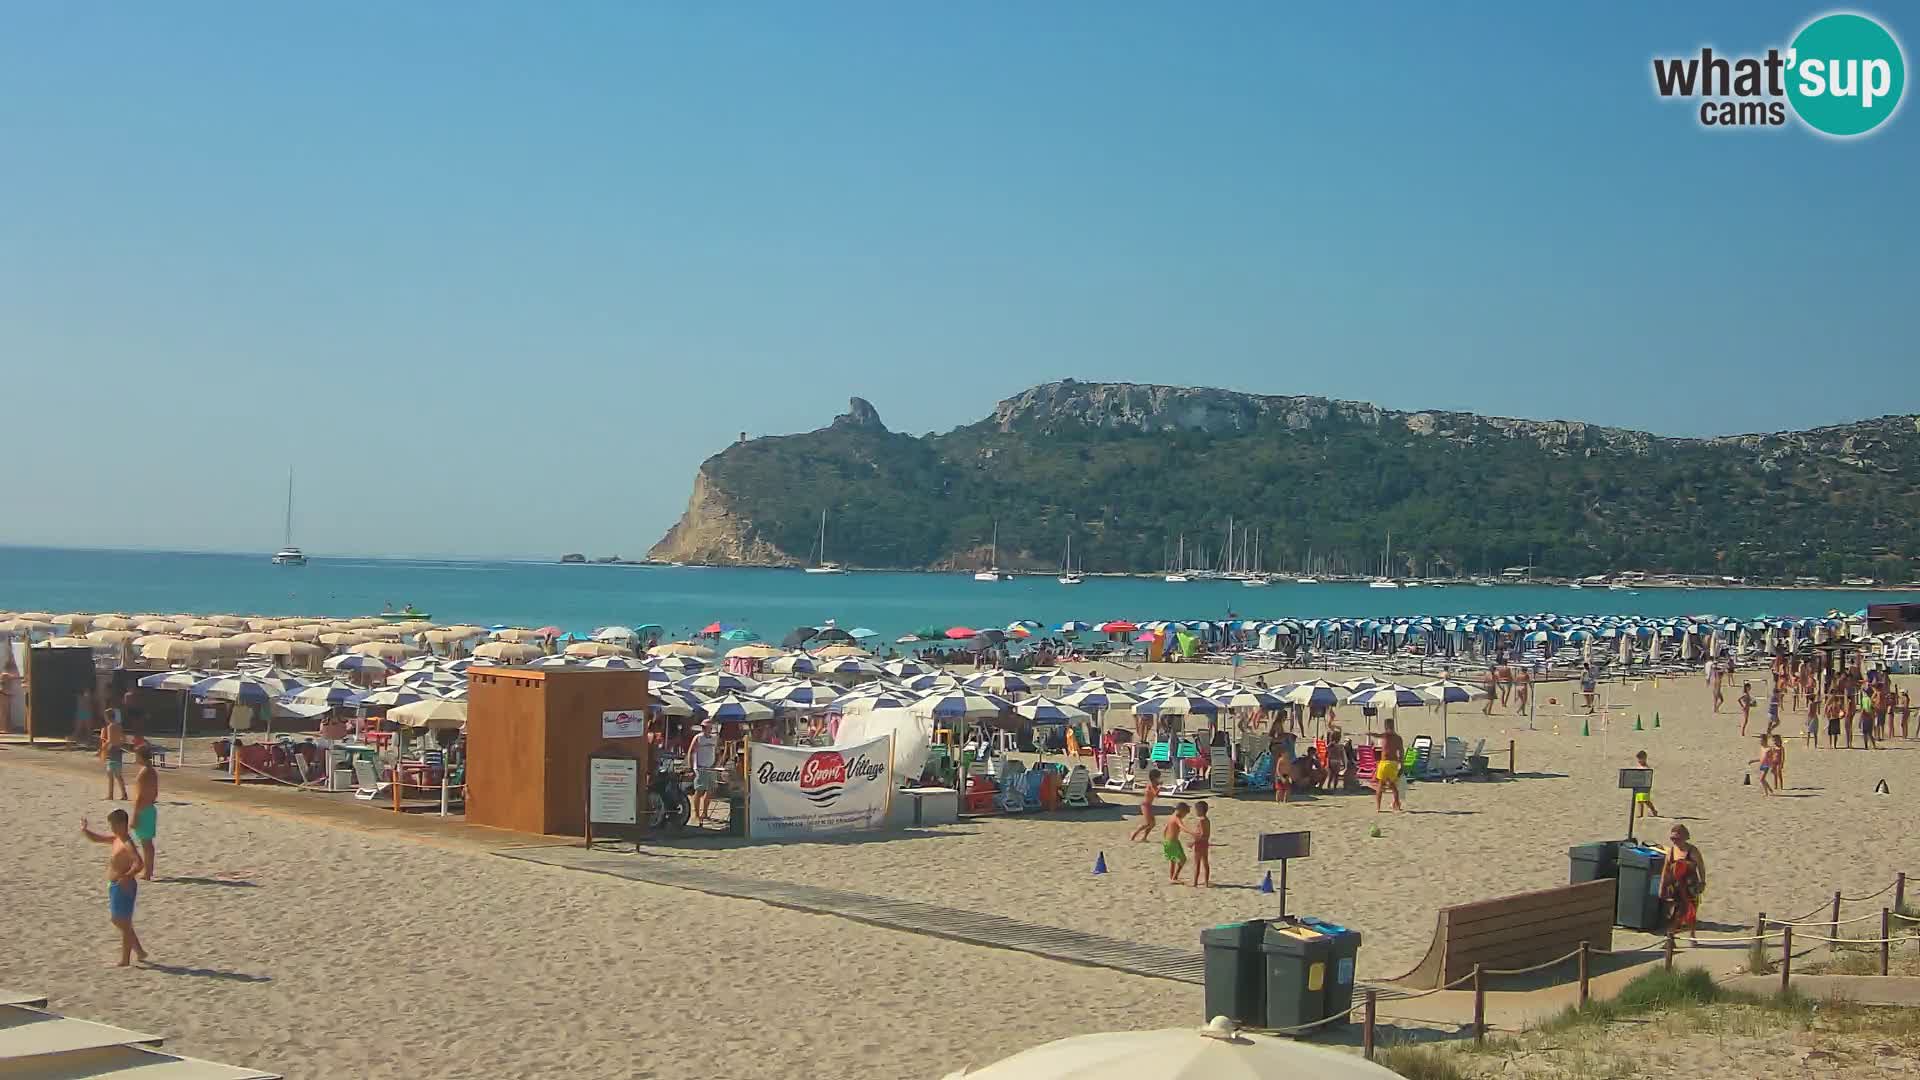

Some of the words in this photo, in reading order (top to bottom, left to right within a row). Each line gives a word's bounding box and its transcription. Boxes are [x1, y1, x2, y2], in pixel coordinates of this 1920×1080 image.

[757, 761, 800, 785] Beach
[804, 759, 845, 786] Sport
[844, 753, 885, 781] Village
